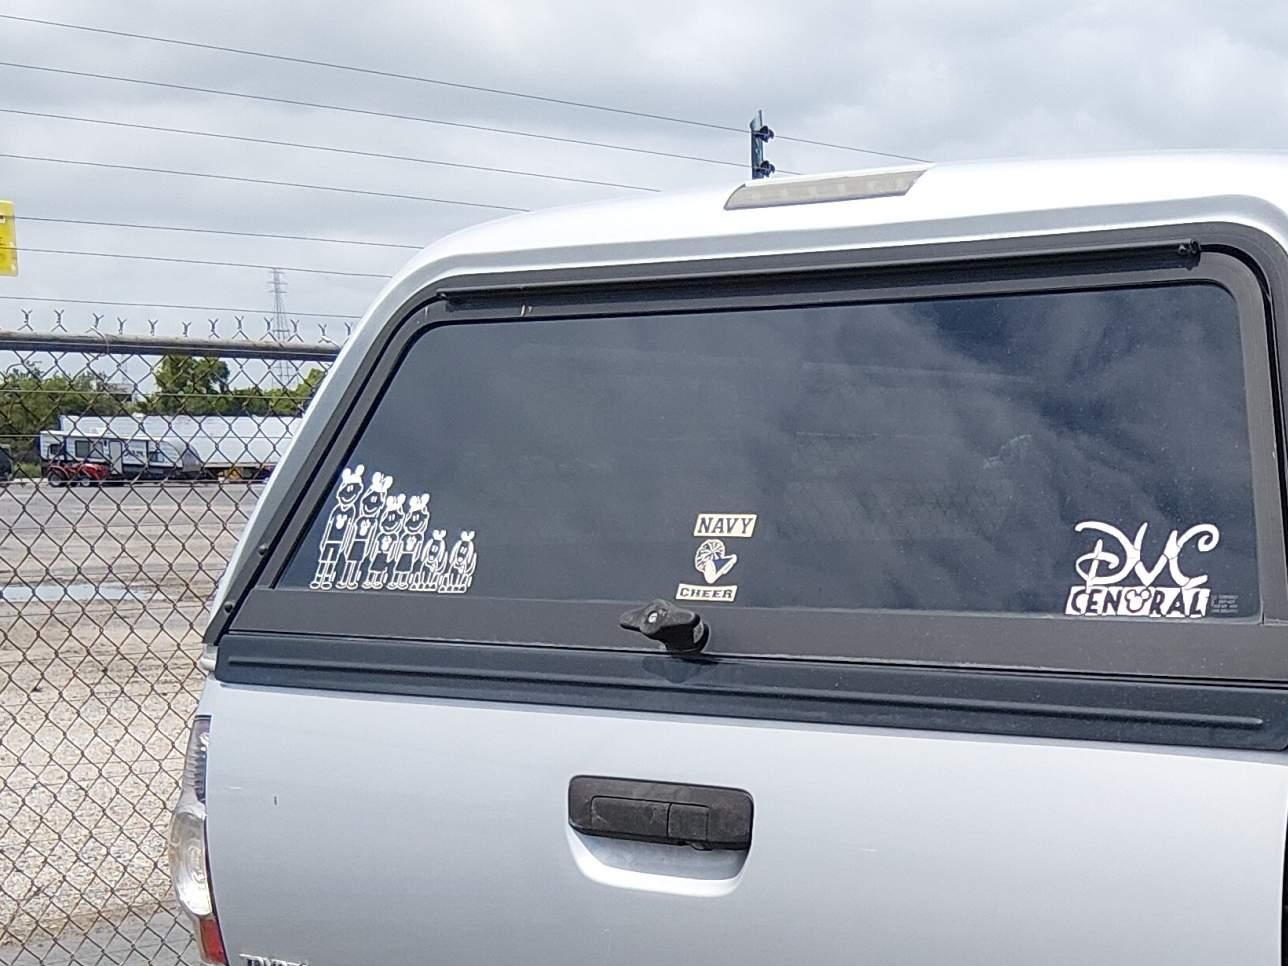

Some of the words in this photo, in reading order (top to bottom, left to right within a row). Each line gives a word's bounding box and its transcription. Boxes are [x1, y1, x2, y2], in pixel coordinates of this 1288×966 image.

[697, 516, 754, 535] NAVY
[1074, 520, 1220, 587] DVC
[679, 587, 734, 599] CHEER
[1068, 588, 1208, 616] CENRAL
